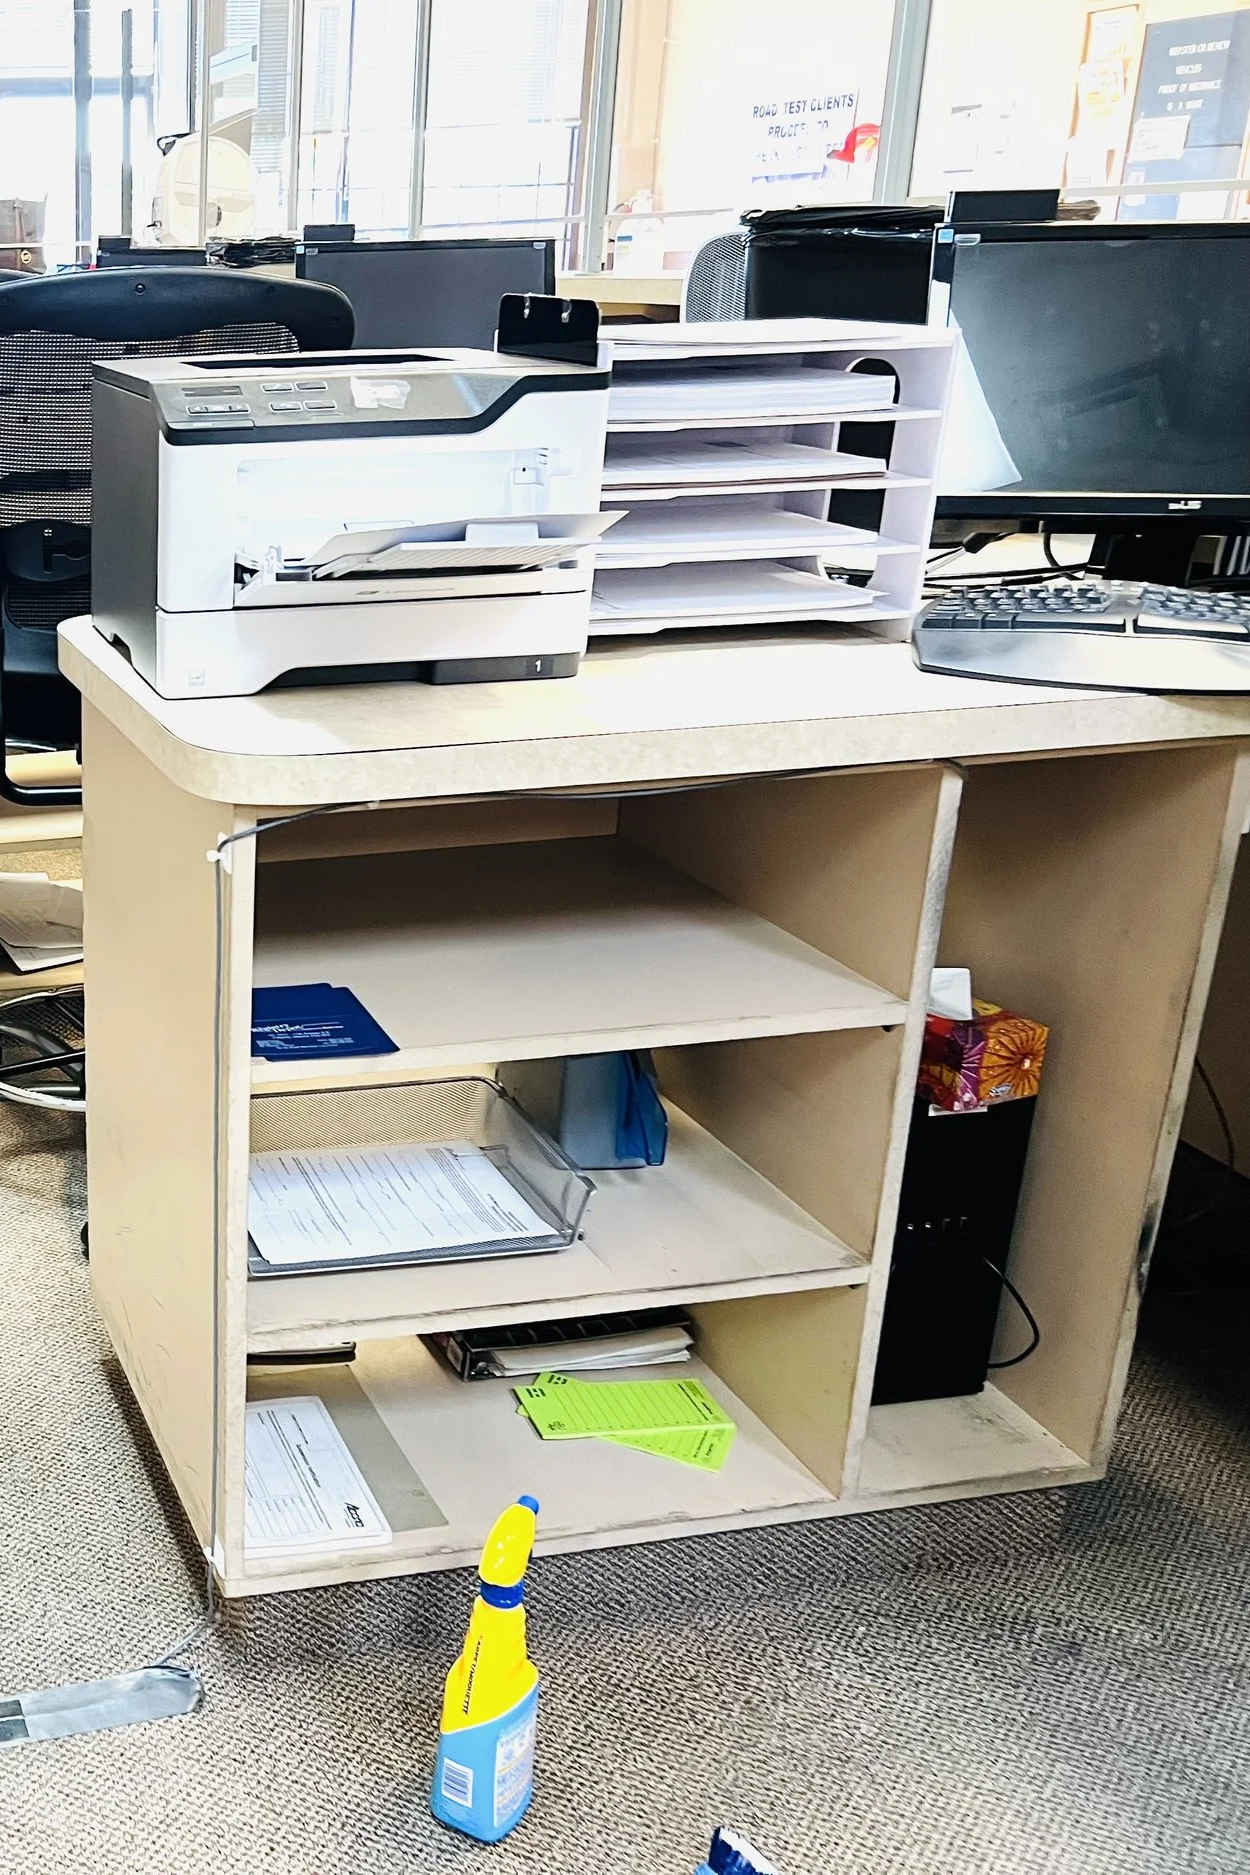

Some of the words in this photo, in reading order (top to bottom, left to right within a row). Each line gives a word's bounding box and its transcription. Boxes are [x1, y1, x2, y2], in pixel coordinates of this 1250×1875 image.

[753, 104, 778, 119] ROAD
[784, 99, 807, 115] TEST
[810, 93, 855, 112] CLIENTS
[535, 659, 541, 672] 1
